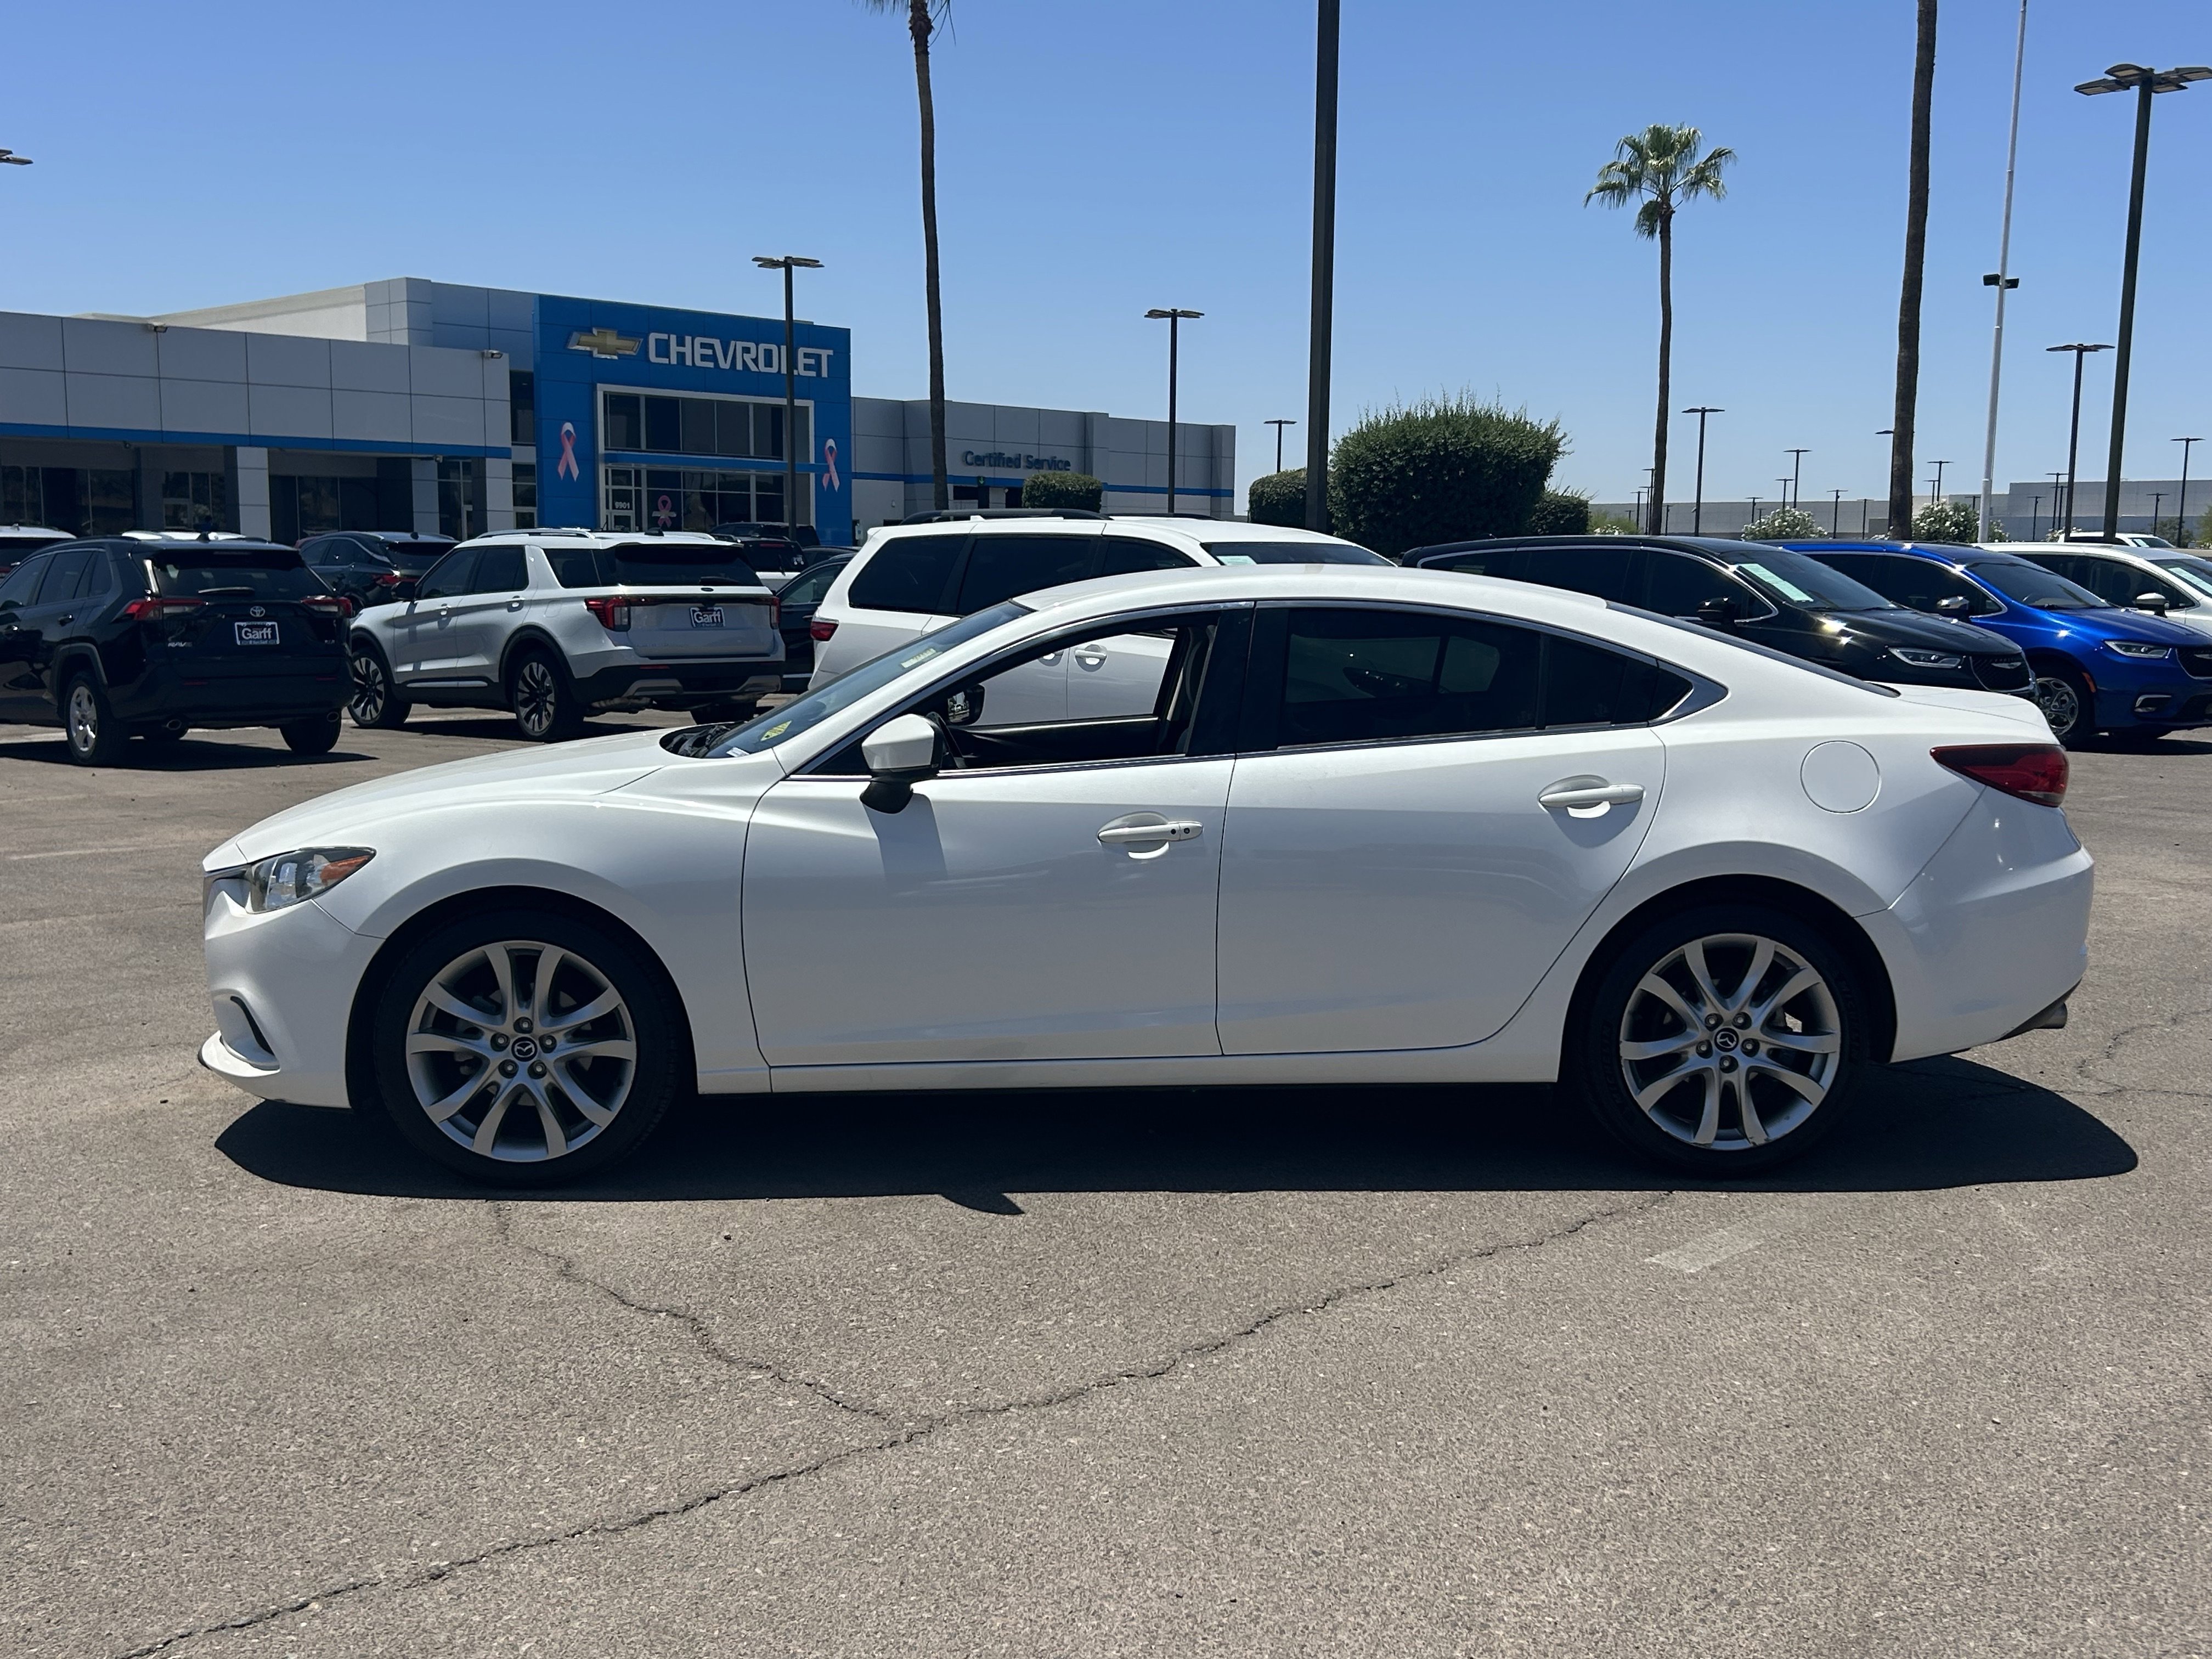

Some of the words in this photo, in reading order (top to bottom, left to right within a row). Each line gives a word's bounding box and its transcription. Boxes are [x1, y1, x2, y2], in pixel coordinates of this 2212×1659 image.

[648, 332, 833, 377] CHEVROLET
[964, 450, 1022, 469] Certified
[1024, 454, 1071, 471] Service
[693, 611, 721, 623] Garff
[241, 628, 272, 640] Garff
